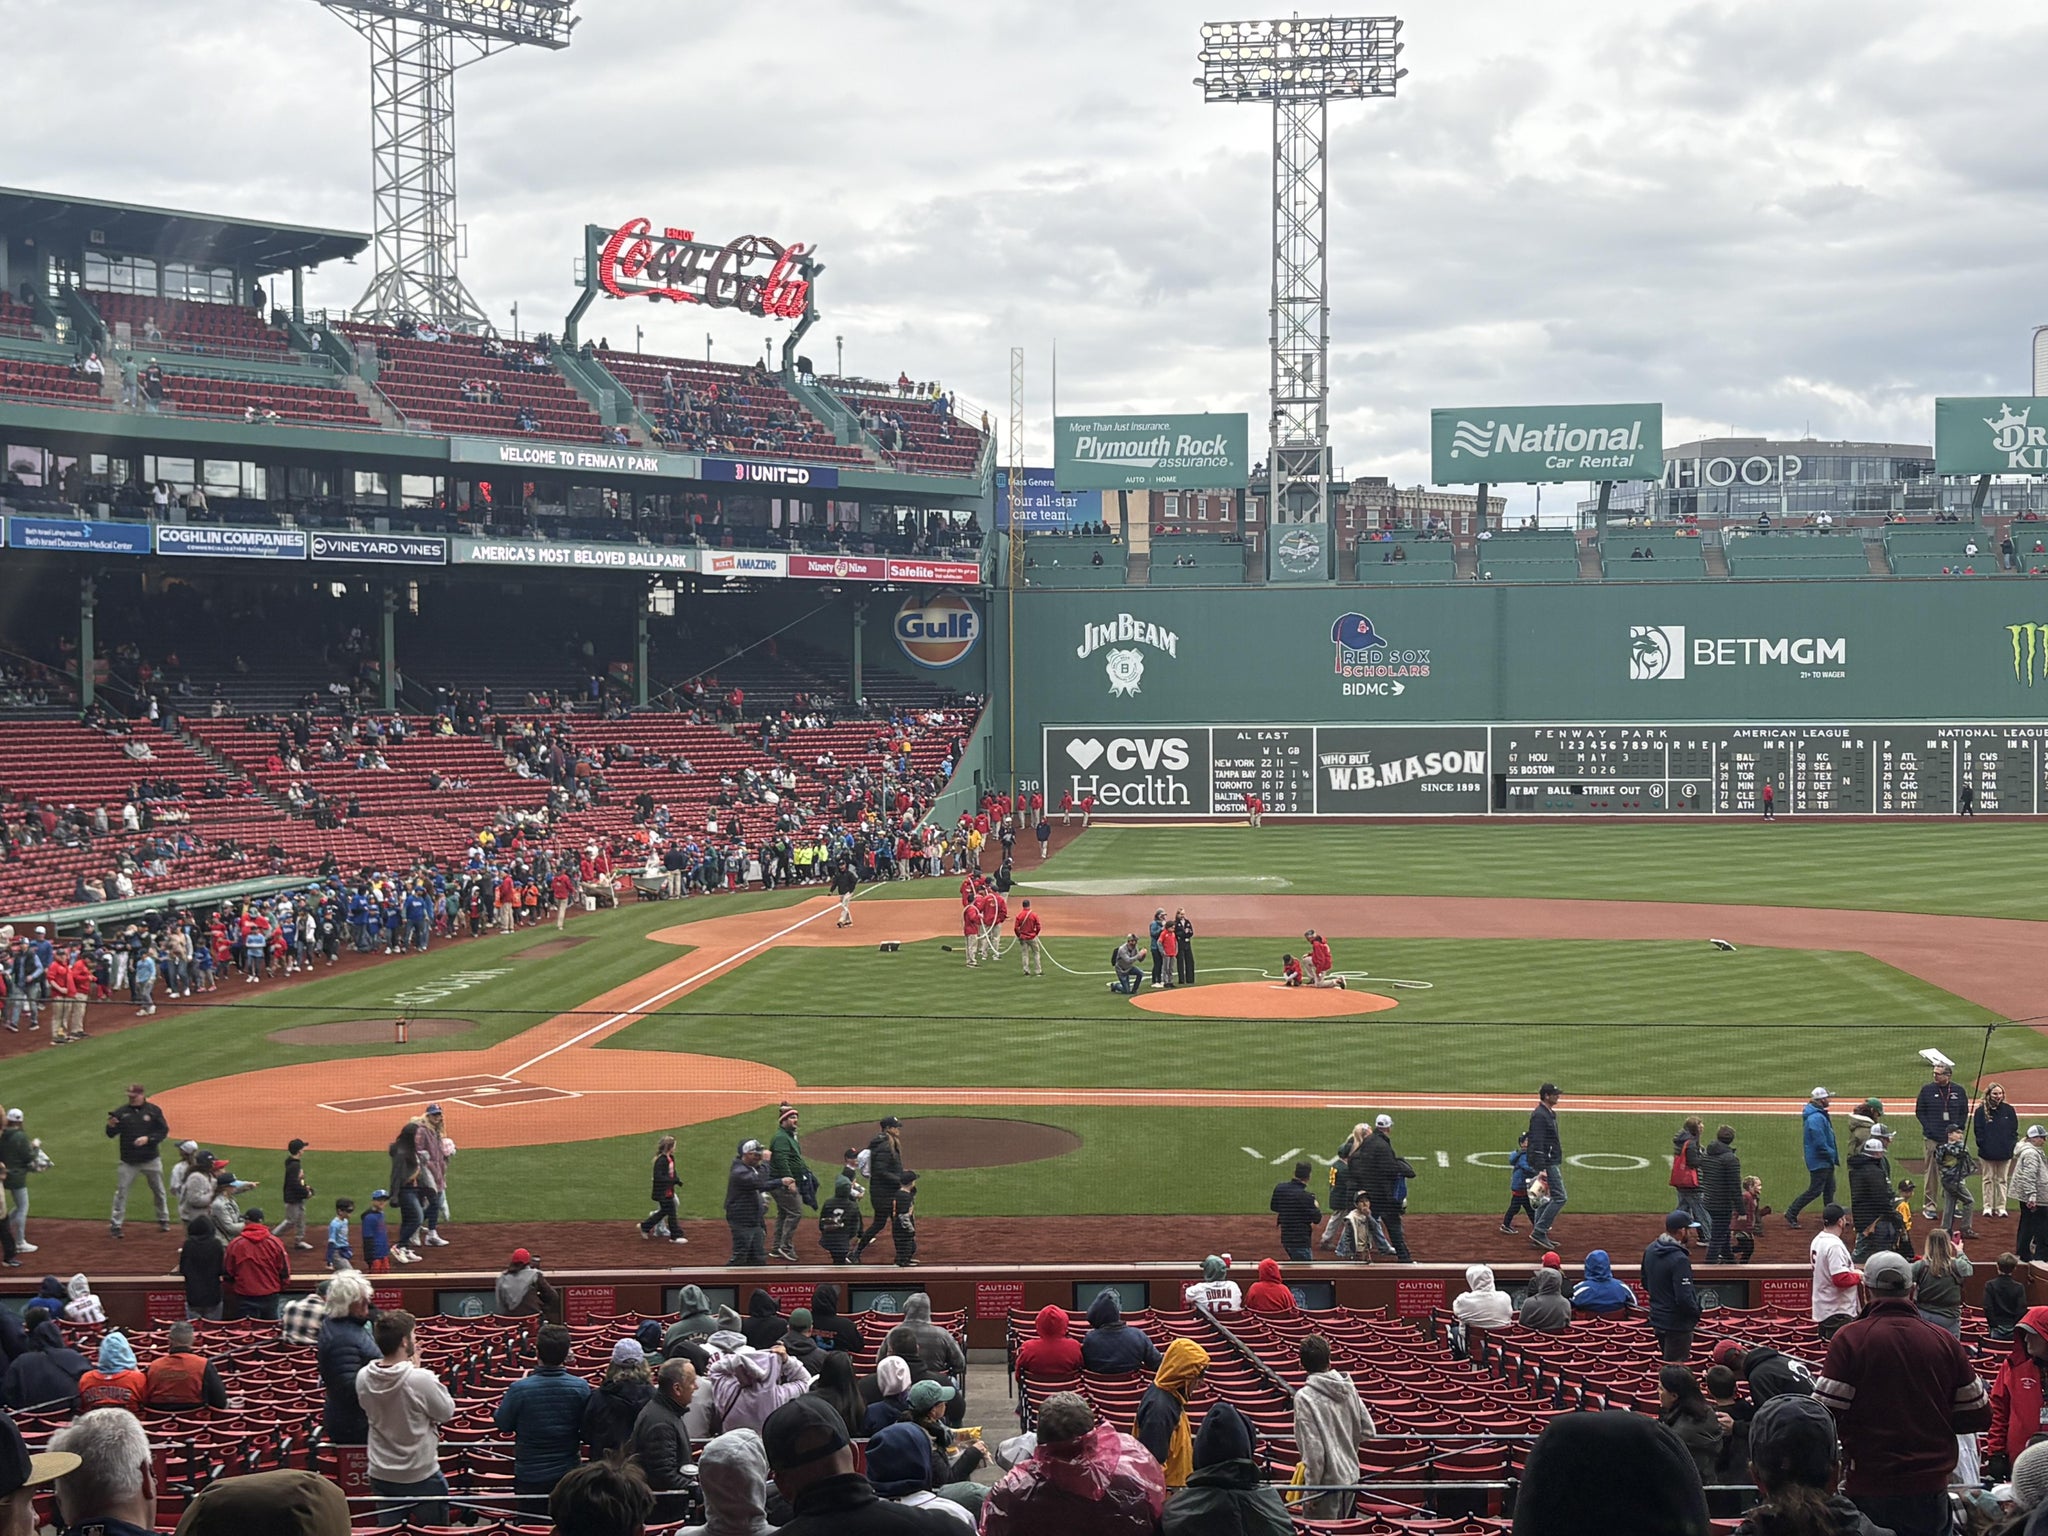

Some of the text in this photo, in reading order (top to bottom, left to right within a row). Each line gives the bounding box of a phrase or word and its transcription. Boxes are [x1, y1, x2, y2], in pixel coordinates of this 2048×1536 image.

[1070, 421, 1171, 432] More Than Just Insurance.
[1075, 434, 1228, 459] Plymouth Rock
[500, 446, 658, 472] WELCOME TO FENWAY PARK
[2008, 446, 2048, 468] KI
[1158, 457, 1229, 468] assurance
[1545, 454, 1635, 469] Car Rental
[752, 465, 810, 484] UNITED
[1125, 476, 1146, 484] AUTO
[1007, 494, 1078, 507] Your all-star
[1012, 510, 1072, 520] care team.
[160, 529, 304, 547] COGHLIN COMPANIES
[327, 540, 441, 556] VINEYARD VINES
[472, 545, 686, 568] AMERICA'S MOST BELOVED BALLPARK
[736, 559, 776, 570] AMAZING
[808, 561, 867, 573] Ninety Nine
[890, 565, 934, 578] Safelite
[898, 613, 973, 639] Gulf
[1694, 638, 1845, 665] BETMGM
[1343, 650, 1430, 664] RED SOX
[1343, 665, 1430, 677] SCHOLARS
[1343, 683, 1388, 695] BIDMC
[1237, 732, 1289, 740] AL EAST
[1535, 730, 1667, 738] FENWAY PARK
[1733, 729, 1850, 737] AMERICAN LEAGUE
[1938, 729, 2048, 737] NATIONAL LEAGUE
[1511, 741, 1708, 749] P 10 R H E
[1721, 741, 1785, 749] P R
[1798, 741, 1863, 749] P R
[1884, 740, 1949, 748] P R
[1965, 740, 2029, 748] P R
[1107, 738, 1190, 770] CVS
[1263, 747, 1300, 755] W L GB
[1320, 754, 1370, 765] WHO BUT
[1736, 753, 1755, 761] BAL
[1816, 753, 1829, 761] KC
[1901, 753, 1917, 761] ATL
[1979, 753, 1998, 761] CWS
[1234, 759, 1254, 767] YORK
[1261, 759, 1272, 767] 22
[1276, 759, 1283, 767] 11
[1736, 763, 1754, 771] NYY
[1813, 763, 1832, 771] SEA
[1900, 762, 1918, 770] COL
[1983, 762, 1995, 770] SD
[1214, 770, 1284, 778] TAMPA BAY 20 12
[1509, 766, 1518, 774] 55
[1521, 766, 1555, 774] BOSTON
[1737, 772, 1754, 780] TOR
[1814, 772, 1832, 780] TEX
[1903, 772, 1915, 780] AZ
[1982, 772, 1996, 780] PHI
[1019, 780, 1039, 791] 310
[1214, 781, 1297, 789] TORONTO 16 17 6
[1421, 783, 1480, 792] SINCE 1898
[1738, 782, 1754, 790] MIN
[1813, 782, 1832, 790] DET
[1900, 782, 1918, 790] CHC
[1982, 782, 1997, 790] MIA
[1070, 775, 1191, 806] Health
[1509, 787, 1640, 795] AT BAT BALL STRIKE OUT
[1262, 792, 1271, 800] 15
[1275, 792, 1284, 800] 18
[1736, 792, 1754, 800] CLE
[1816, 792, 1829, 800] SF
[1901, 792, 1917, 800] CIN
[1981, 792, 1997, 800] MIL
[1291, 803, 1297, 811] 9
[1901, 801, 1916, 809] PIT
[1980, 801, 1998, 809] WSH
[1206, 1288, 1232, 1300] DURAN
